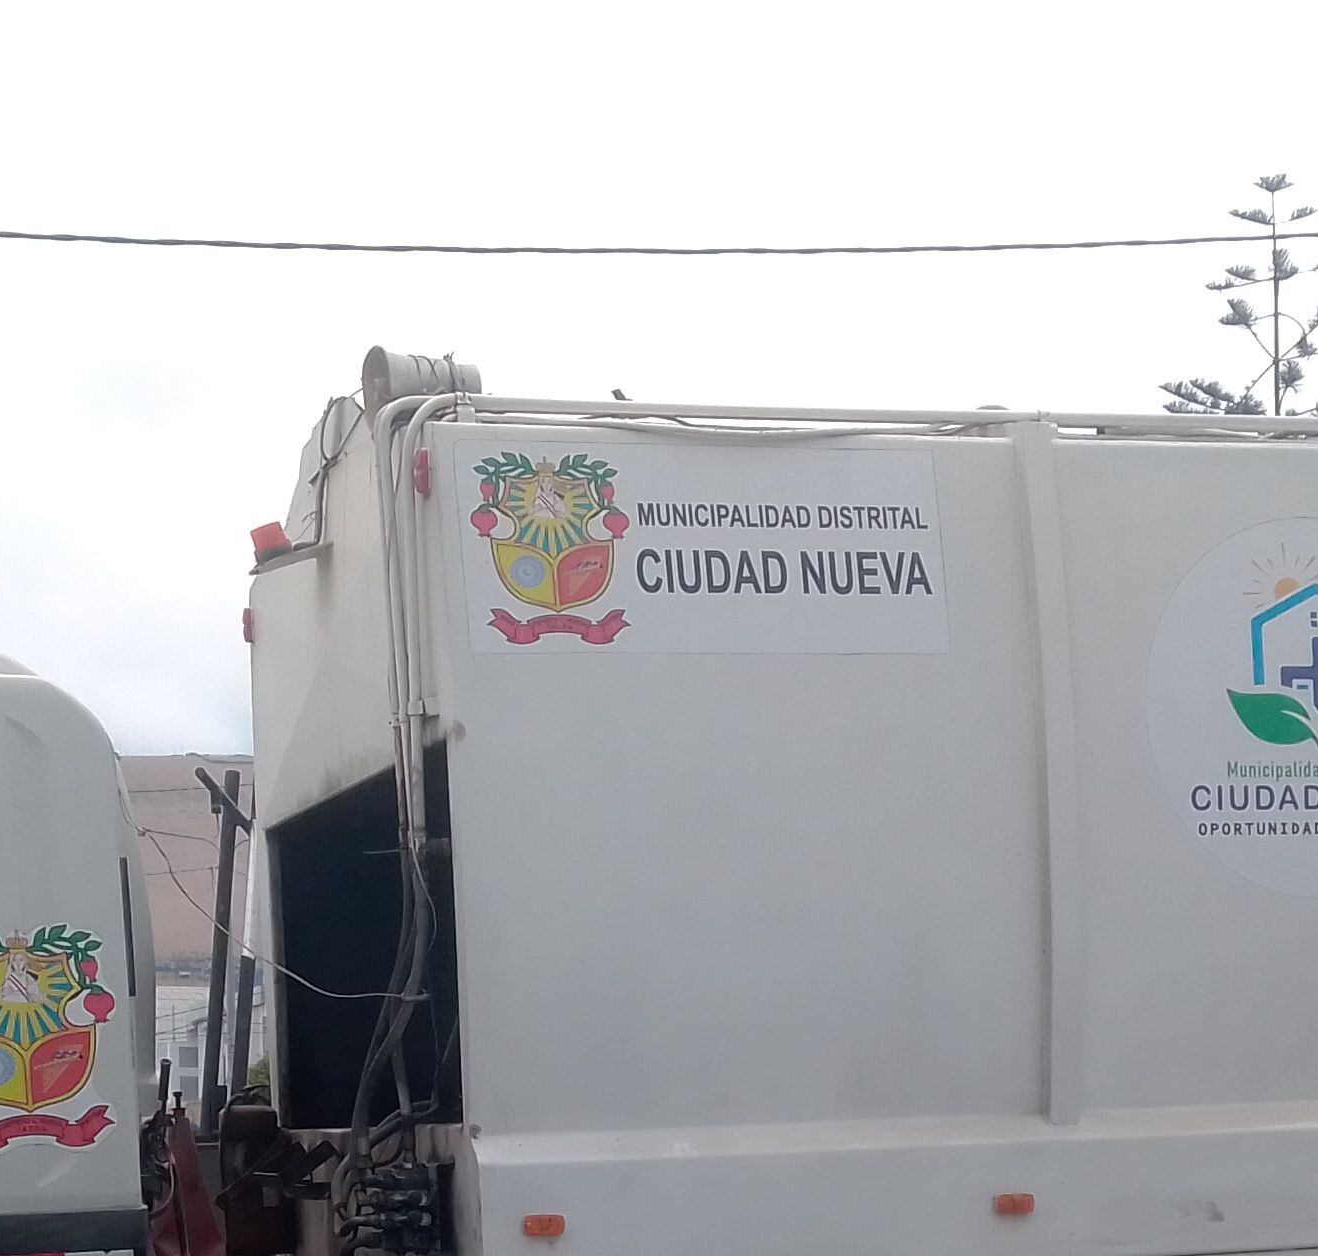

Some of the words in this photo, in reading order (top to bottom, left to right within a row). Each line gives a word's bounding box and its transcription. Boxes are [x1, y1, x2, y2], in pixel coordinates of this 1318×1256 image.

[637, 502, 811, 528] MUNICIPALIDAD
[818, 505, 929, 530] DISTRITAL
[636, 548, 788, 595] CIUDAD
[800, 550, 934, 595] NUEVA
